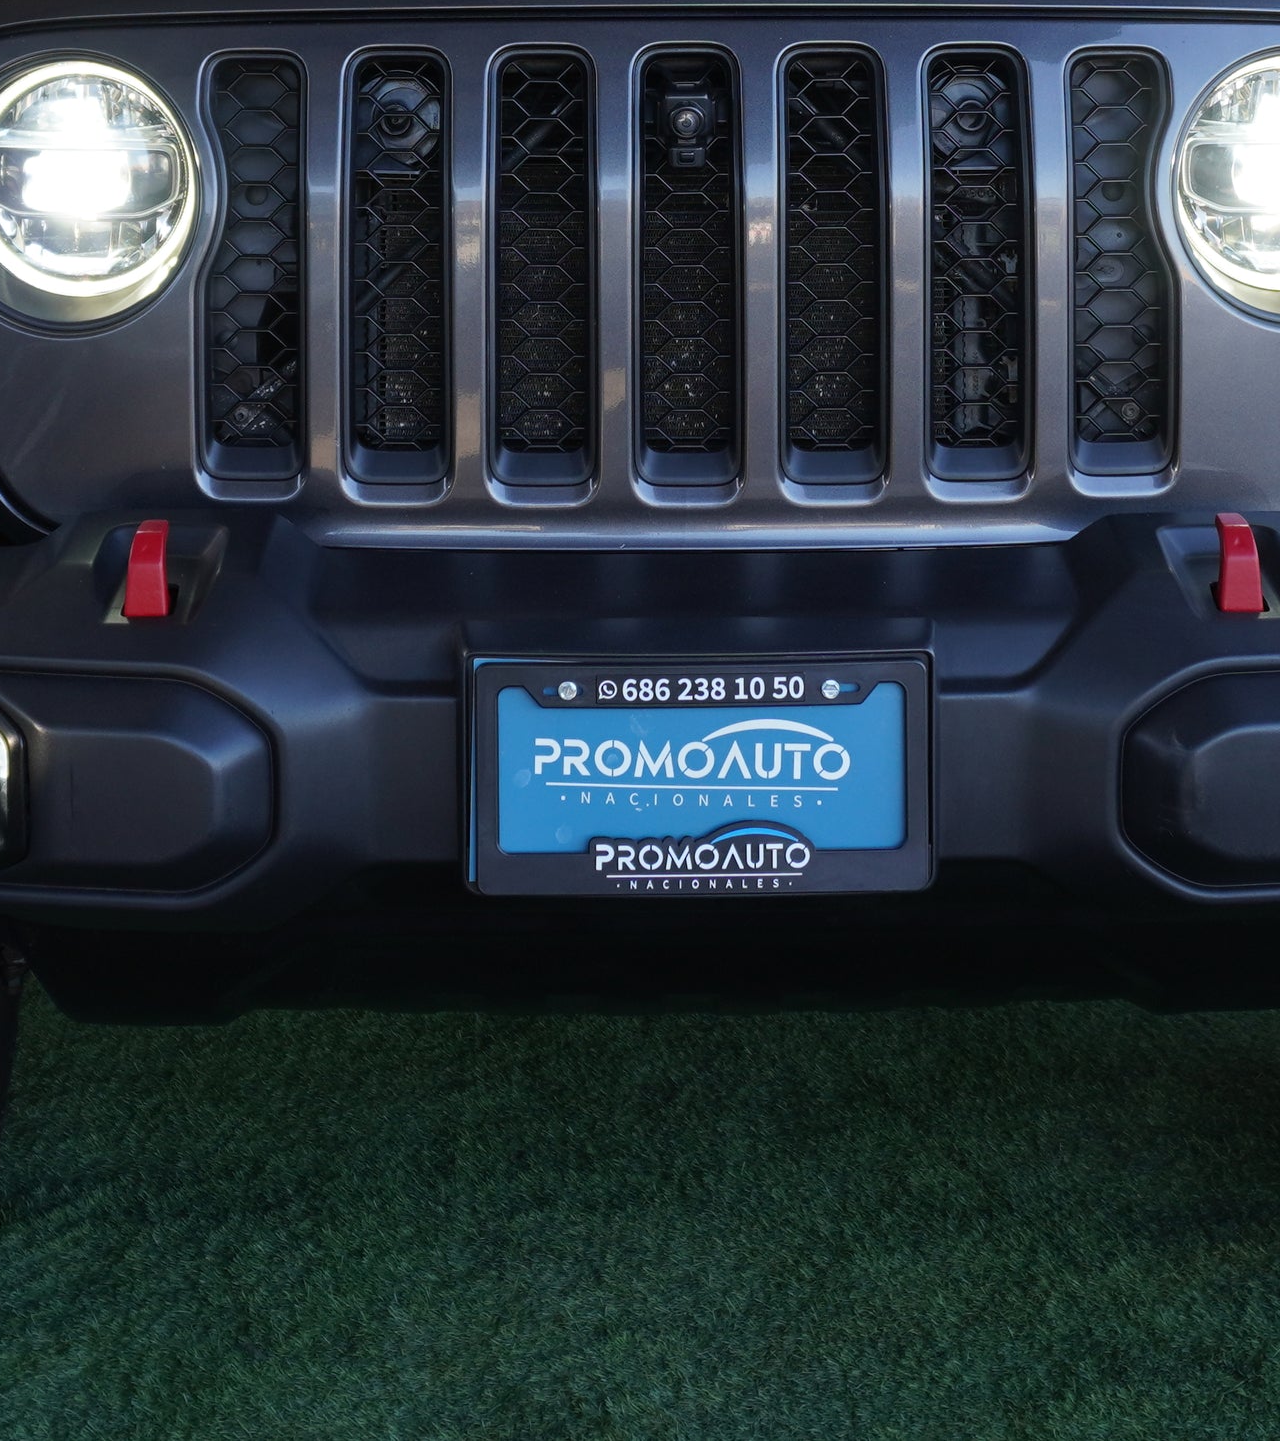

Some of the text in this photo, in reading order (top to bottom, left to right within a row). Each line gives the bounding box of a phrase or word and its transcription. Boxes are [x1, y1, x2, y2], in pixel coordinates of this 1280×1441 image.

[622, 675, 805, 702] 686 238 10 50
[534, 737, 851, 781] PROMOAUTO
[580, 790, 803, 809] NACIONALES
[595, 842, 811, 871] PROMOAUTO
[630, 877, 780, 889] NACIONALES
